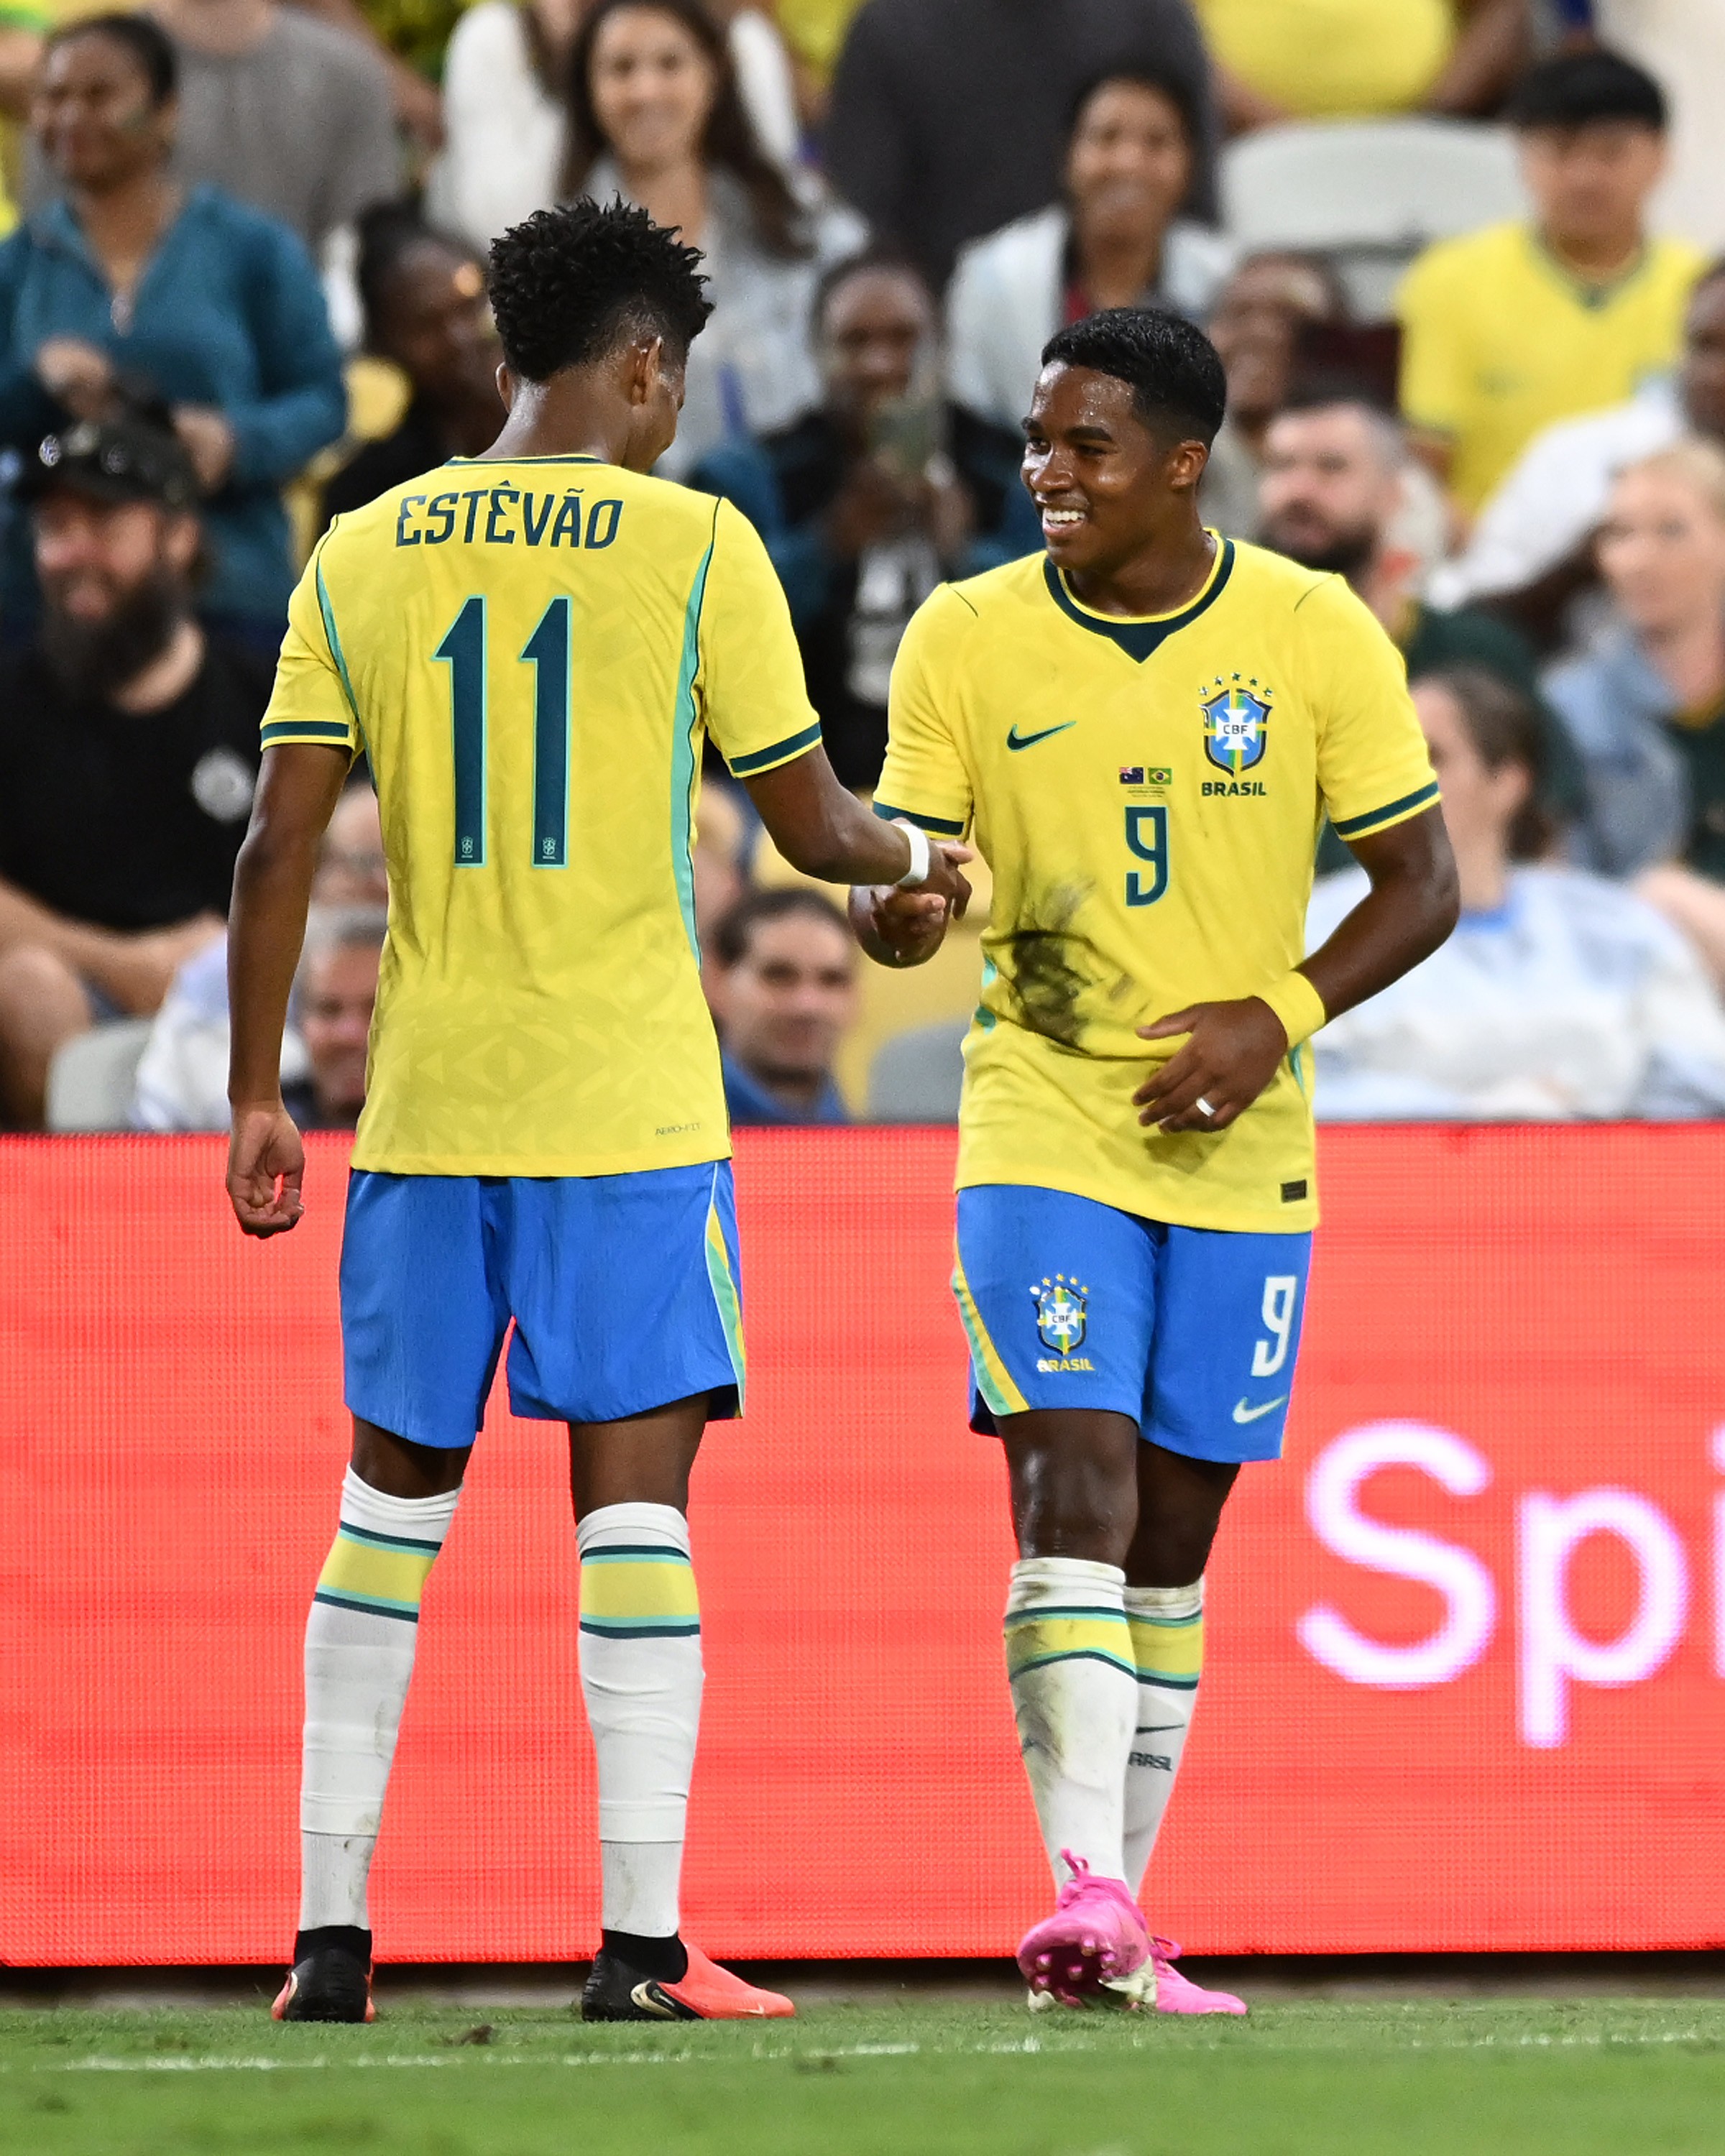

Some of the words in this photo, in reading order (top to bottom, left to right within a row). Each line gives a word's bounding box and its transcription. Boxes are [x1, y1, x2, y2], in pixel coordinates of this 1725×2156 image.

[395, 480, 623, 549] ESTÊVÃO
[430, 594, 573, 868] 11
[1223, 724, 1248, 734] CBF
[1202, 782, 1267, 797] BRASIL
[1124, 805, 1169, 907] 9
[1052, 1314, 1072, 1324] CBF
[1251, 1276, 1296, 1376] 9
